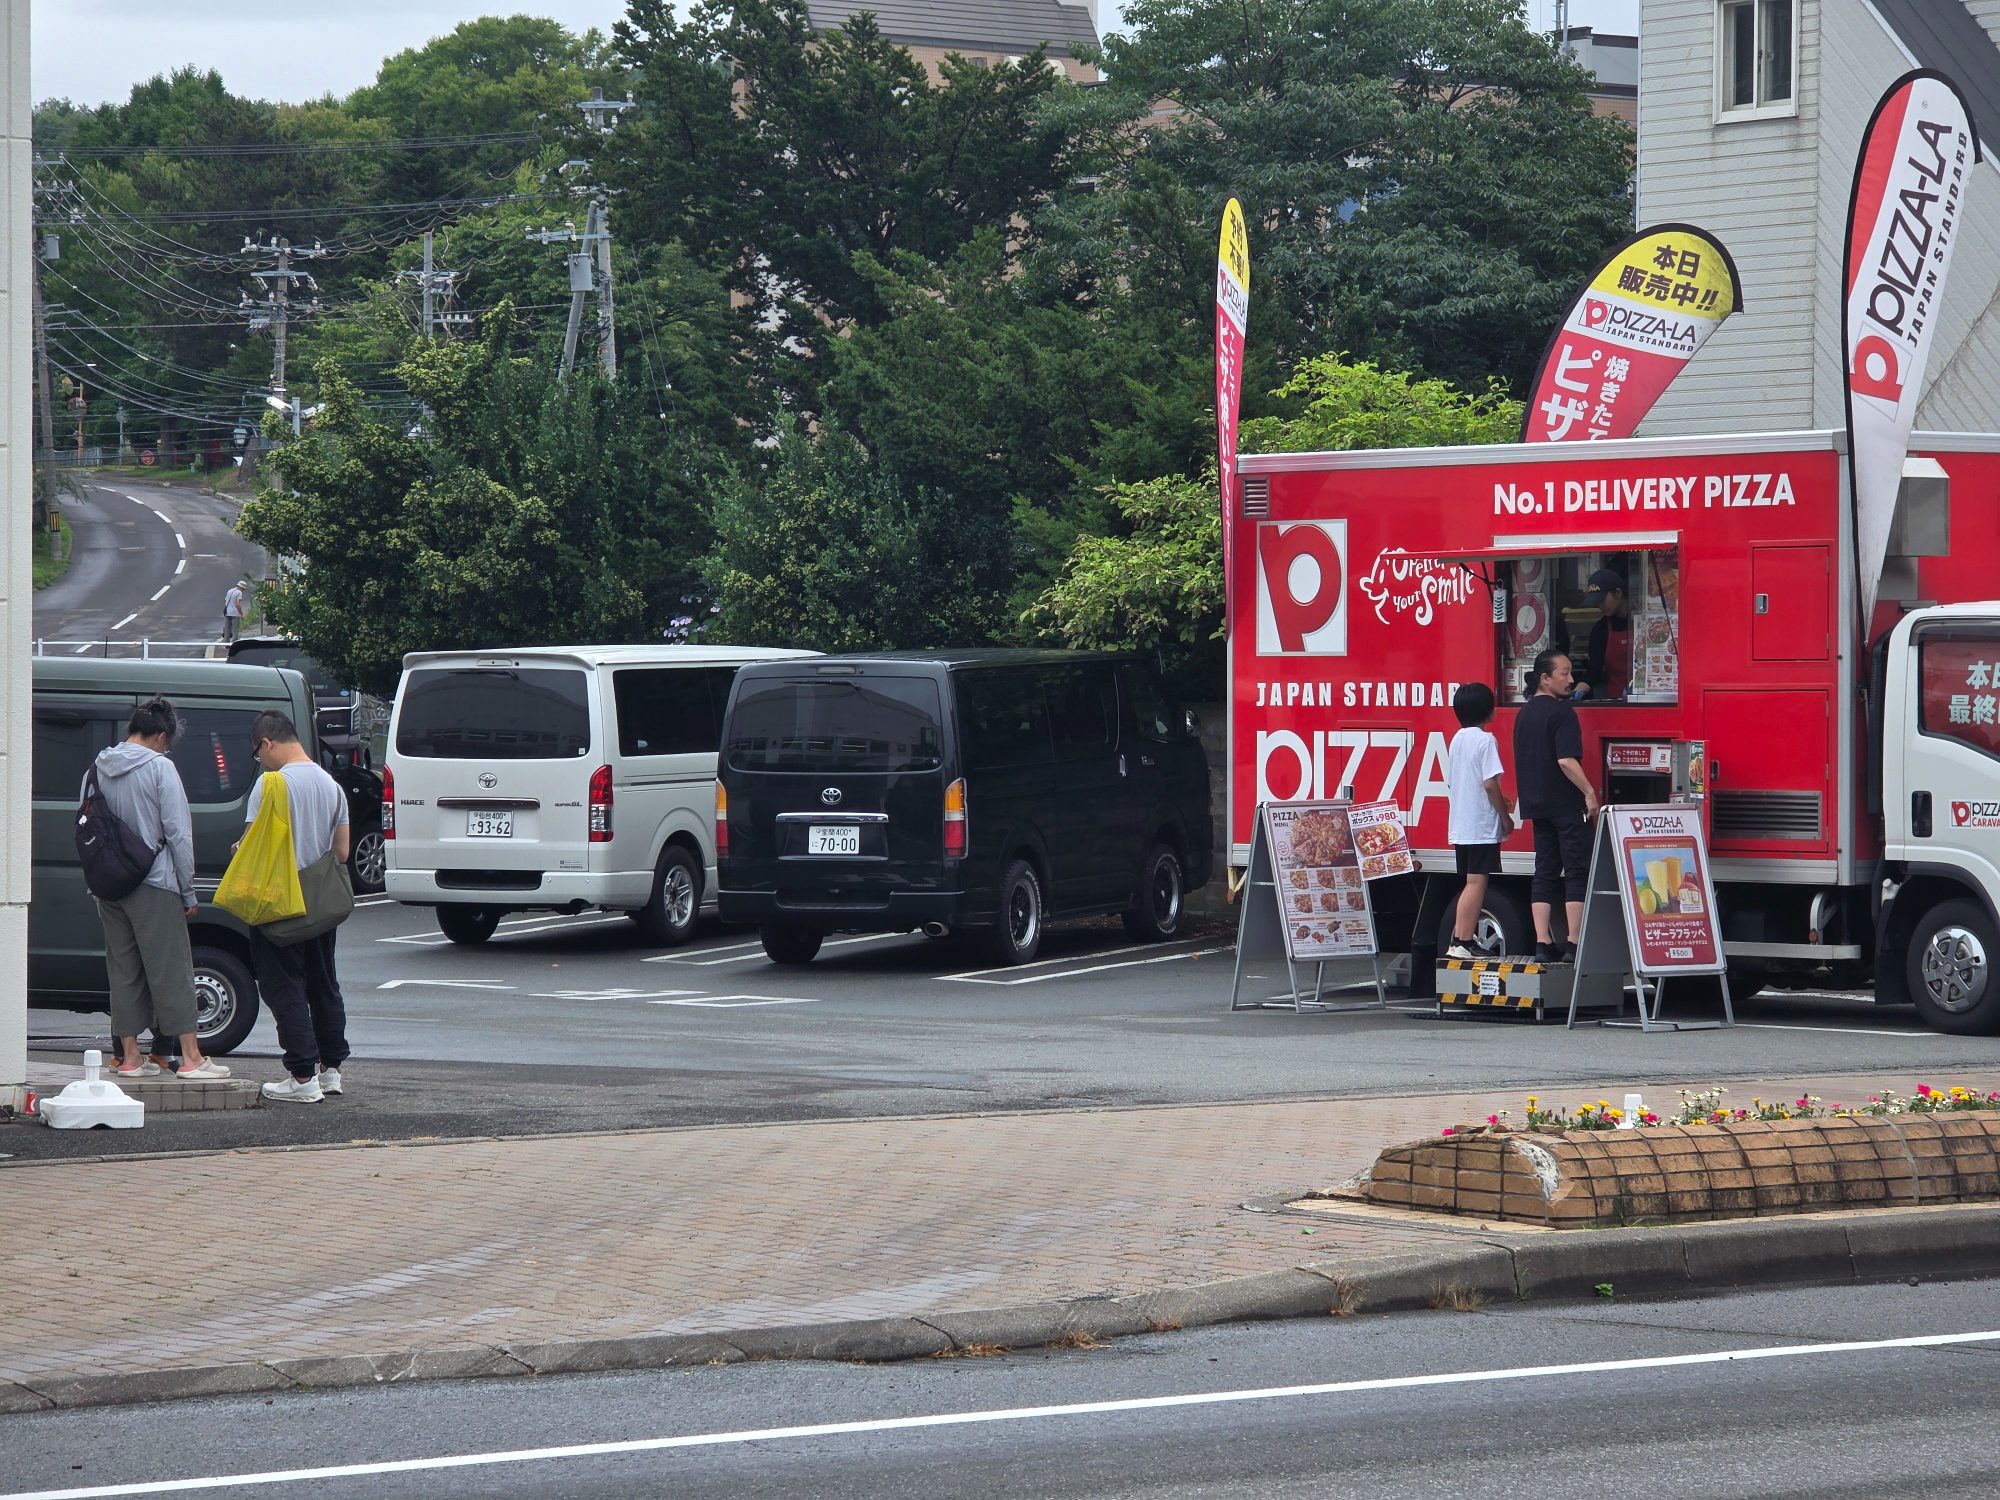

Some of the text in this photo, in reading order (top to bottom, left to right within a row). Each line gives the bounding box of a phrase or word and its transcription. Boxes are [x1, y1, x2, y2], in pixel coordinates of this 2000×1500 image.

[1907, 131, 1968, 348] JAPAN STANDARD
[1652, 244, 1701, 279] 本日
[1605, 326, 1695, 352] JAPAN STANDARD
[1541, 344, 1603, 442] ピザ
[1493, 472, 1796, 515] No.1 DELIVERY PIZZA
[1392, 589, 1421, 613] your
[1415, 566, 1475, 626] Smile
[1256, 682, 1461, 707] JAPAN STANDAR
[1948, 694, 2000, 725] 最終
[1256, 729, 1451, 828] PIZZA
[477, 820, 511, 835] 93-62
[492, 812, 504, 820] 400
[1272, 811, 1300, 821] PIZZA
[820, 837, 856, 851] 70-00
[836, 828, 849, 836] 400
[1644, 928, 1707, 940] ピザーラフラッペ
